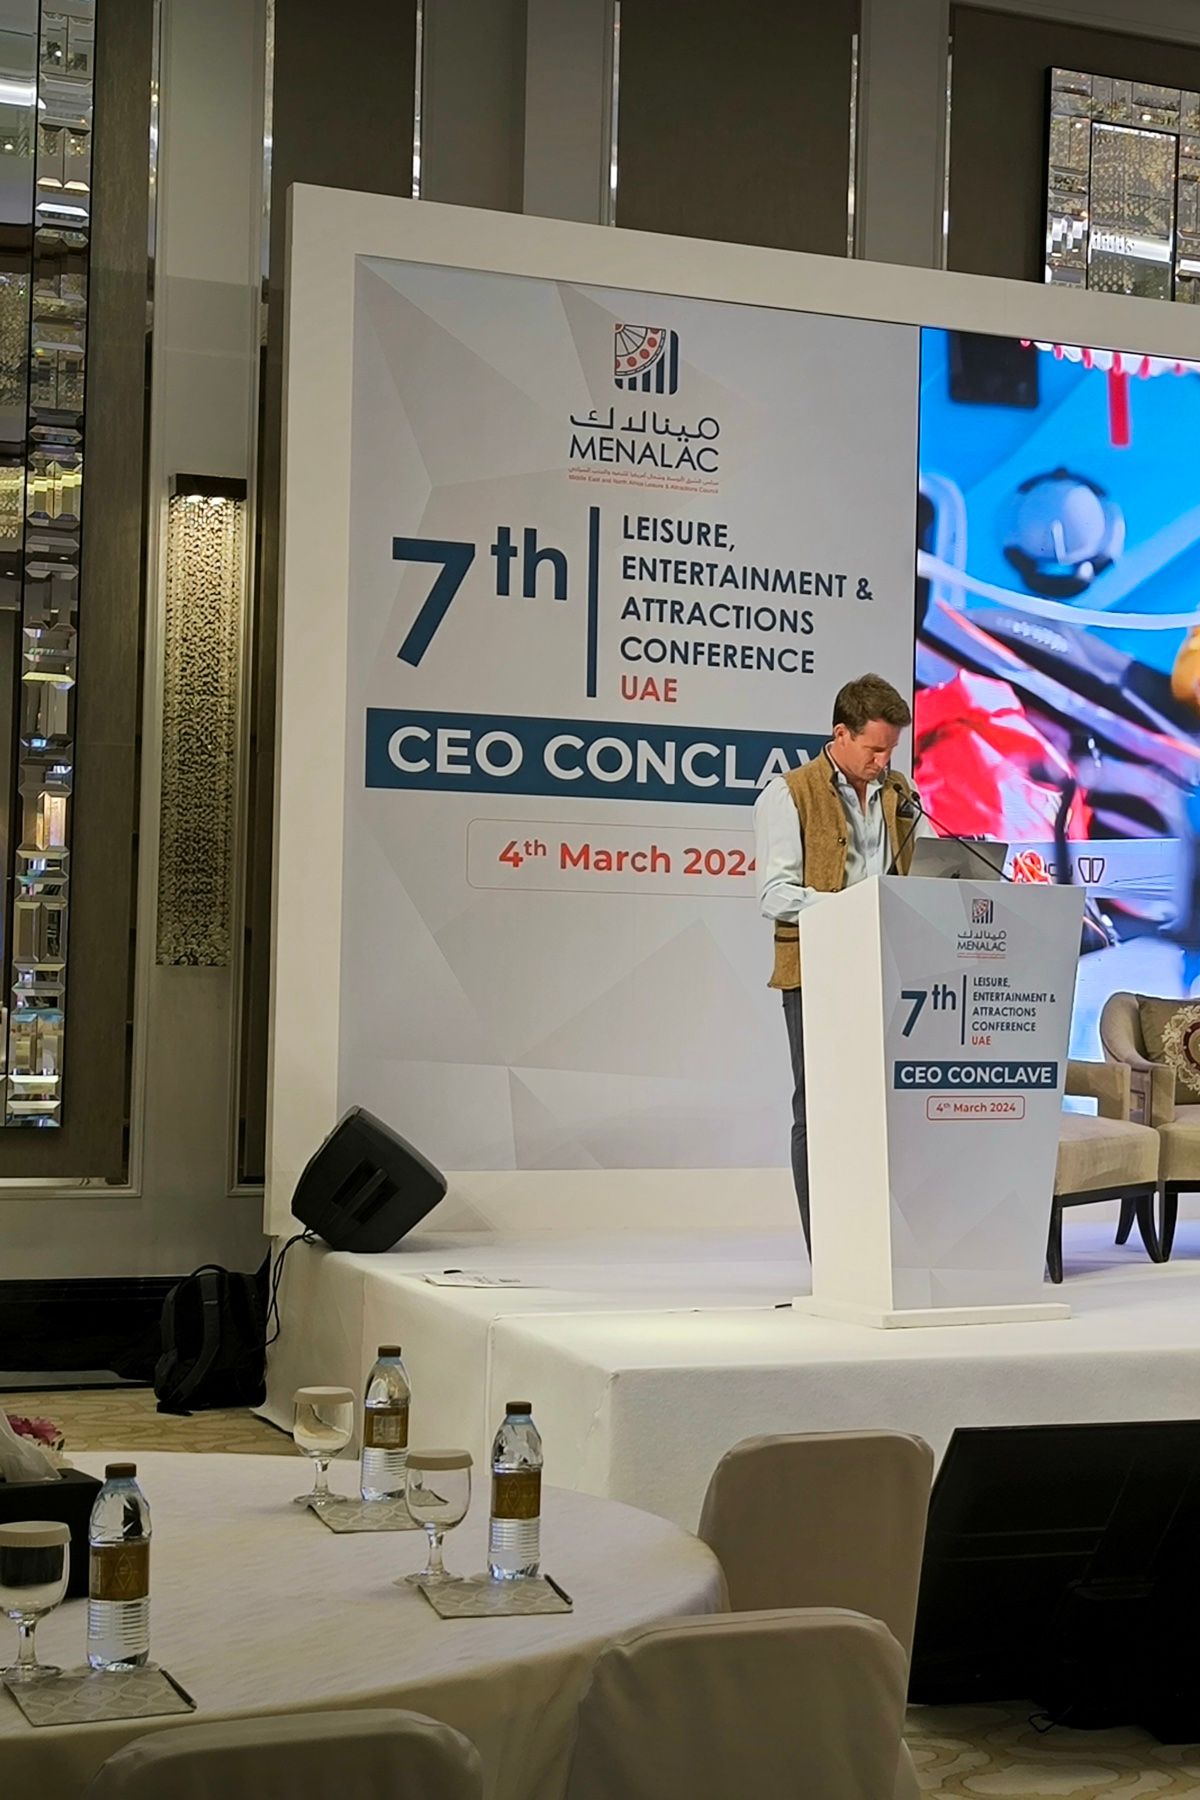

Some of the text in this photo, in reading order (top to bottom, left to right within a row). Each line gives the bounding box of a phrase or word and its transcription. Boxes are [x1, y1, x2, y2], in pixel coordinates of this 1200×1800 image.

[569, 433, 719, 473] MENALAC
[622, 514, 736, 552] LEISURE,
[621, 556, 874, 601] ENTERTAINMENT &
[392, 526, 568, 668] 7th
[620, 596, 815, 635] ATTRACTIONS
[619, 636, 816, 674] CONFERENCE
[620, 675, 678, 702] UAE
[387, 726, 813, 790] CEO CONCLA
[498, 839, 547, 868] 4th
[559, 843, 671, 874] March
[957, 940, 1006, 952] MENALAC
[973, 977, 1010, 988] LEISURE,
[973, 991, 1056, 1003] ENTERTAINMENT &
[901, 984, 956, 1037] 7th
[972, 1006, 1037, 1017] ATTRACTIONS
[971, 1021, 1037, 1032] CONFERENCE
[971, 1035, 992, 1045] UAE
[900, 1066, 1052, 1084] CEO CONCLAVE
[953, 1103, 987, 1112] March
[990, 1103, 1016, 1112] 2024
